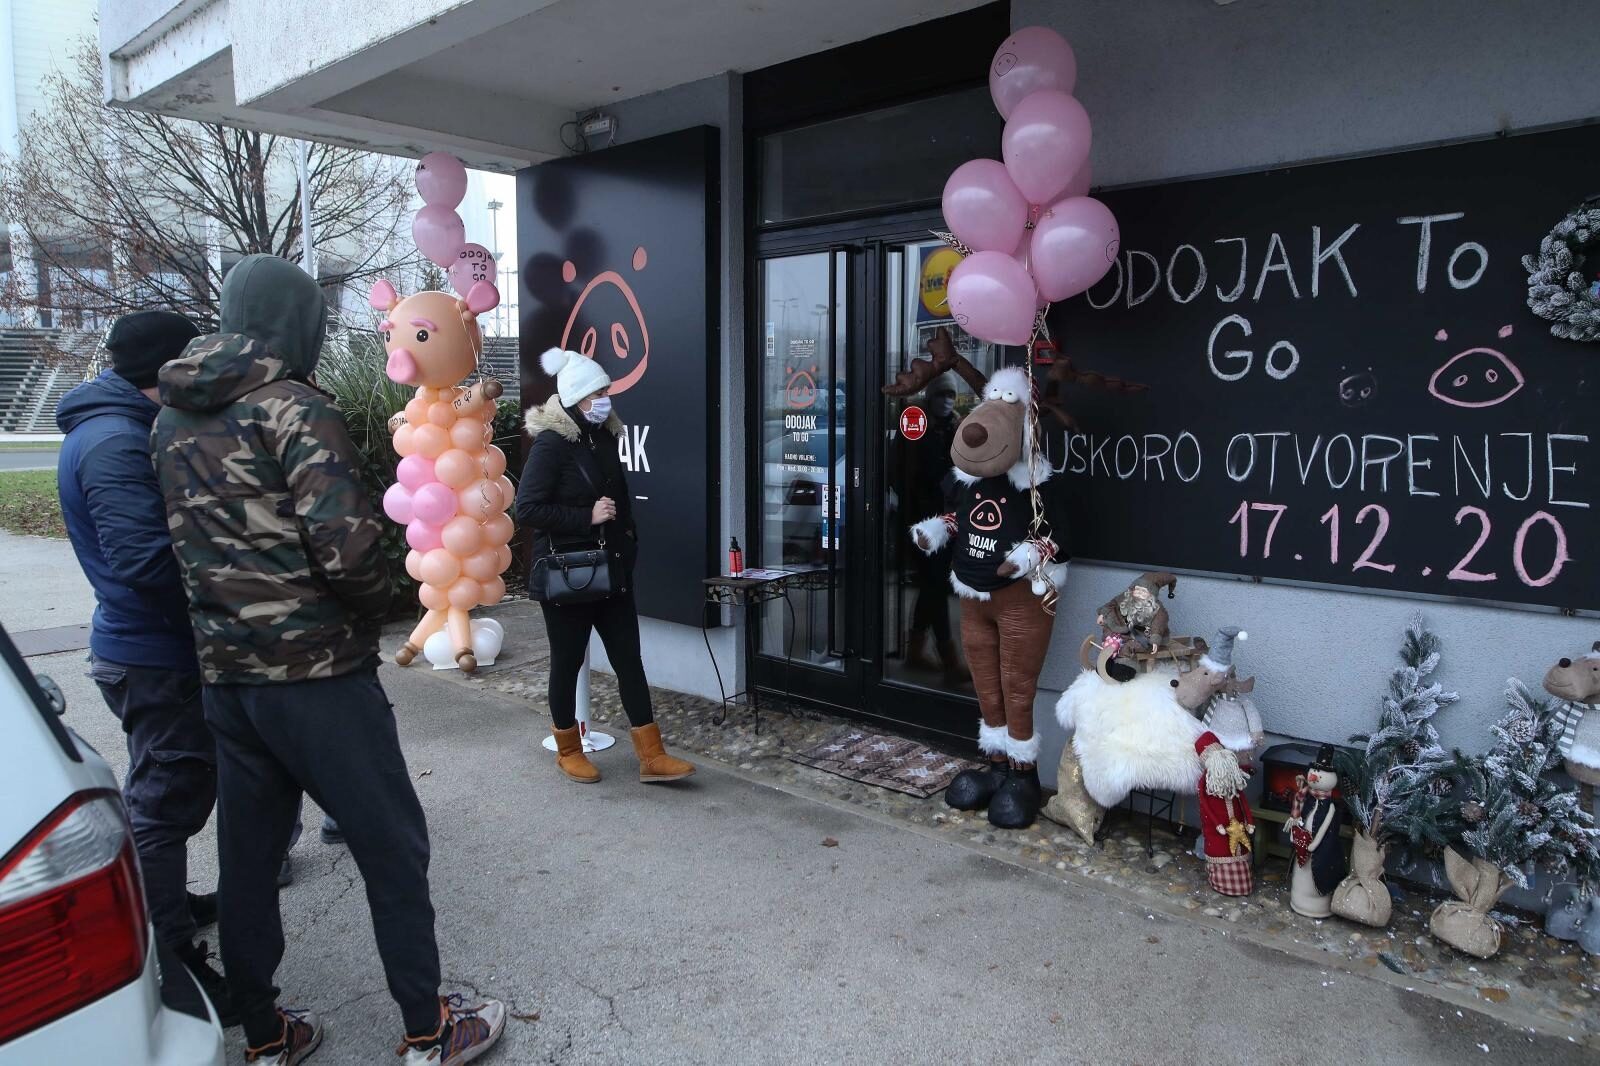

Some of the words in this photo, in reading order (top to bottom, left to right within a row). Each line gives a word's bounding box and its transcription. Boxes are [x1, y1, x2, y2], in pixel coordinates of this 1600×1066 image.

[472, 262, 487, 272] TO
[1085, 223, 1361, 309] ODOJAK
[1397, 212, 1488, 293] To
[1207, 314, 1300, 381] Go
[453, 399, 462, 409] TO
[785, 414, 817, 430] ODOJAK
[792, 432, 800, 442] TO
[801, 432, 809, 442] GO
[1045, 430, 1201, 482] USKORO
[1225, 433, 1590, 508] OTVORENJE
[968, 547, 976, 557] TO
